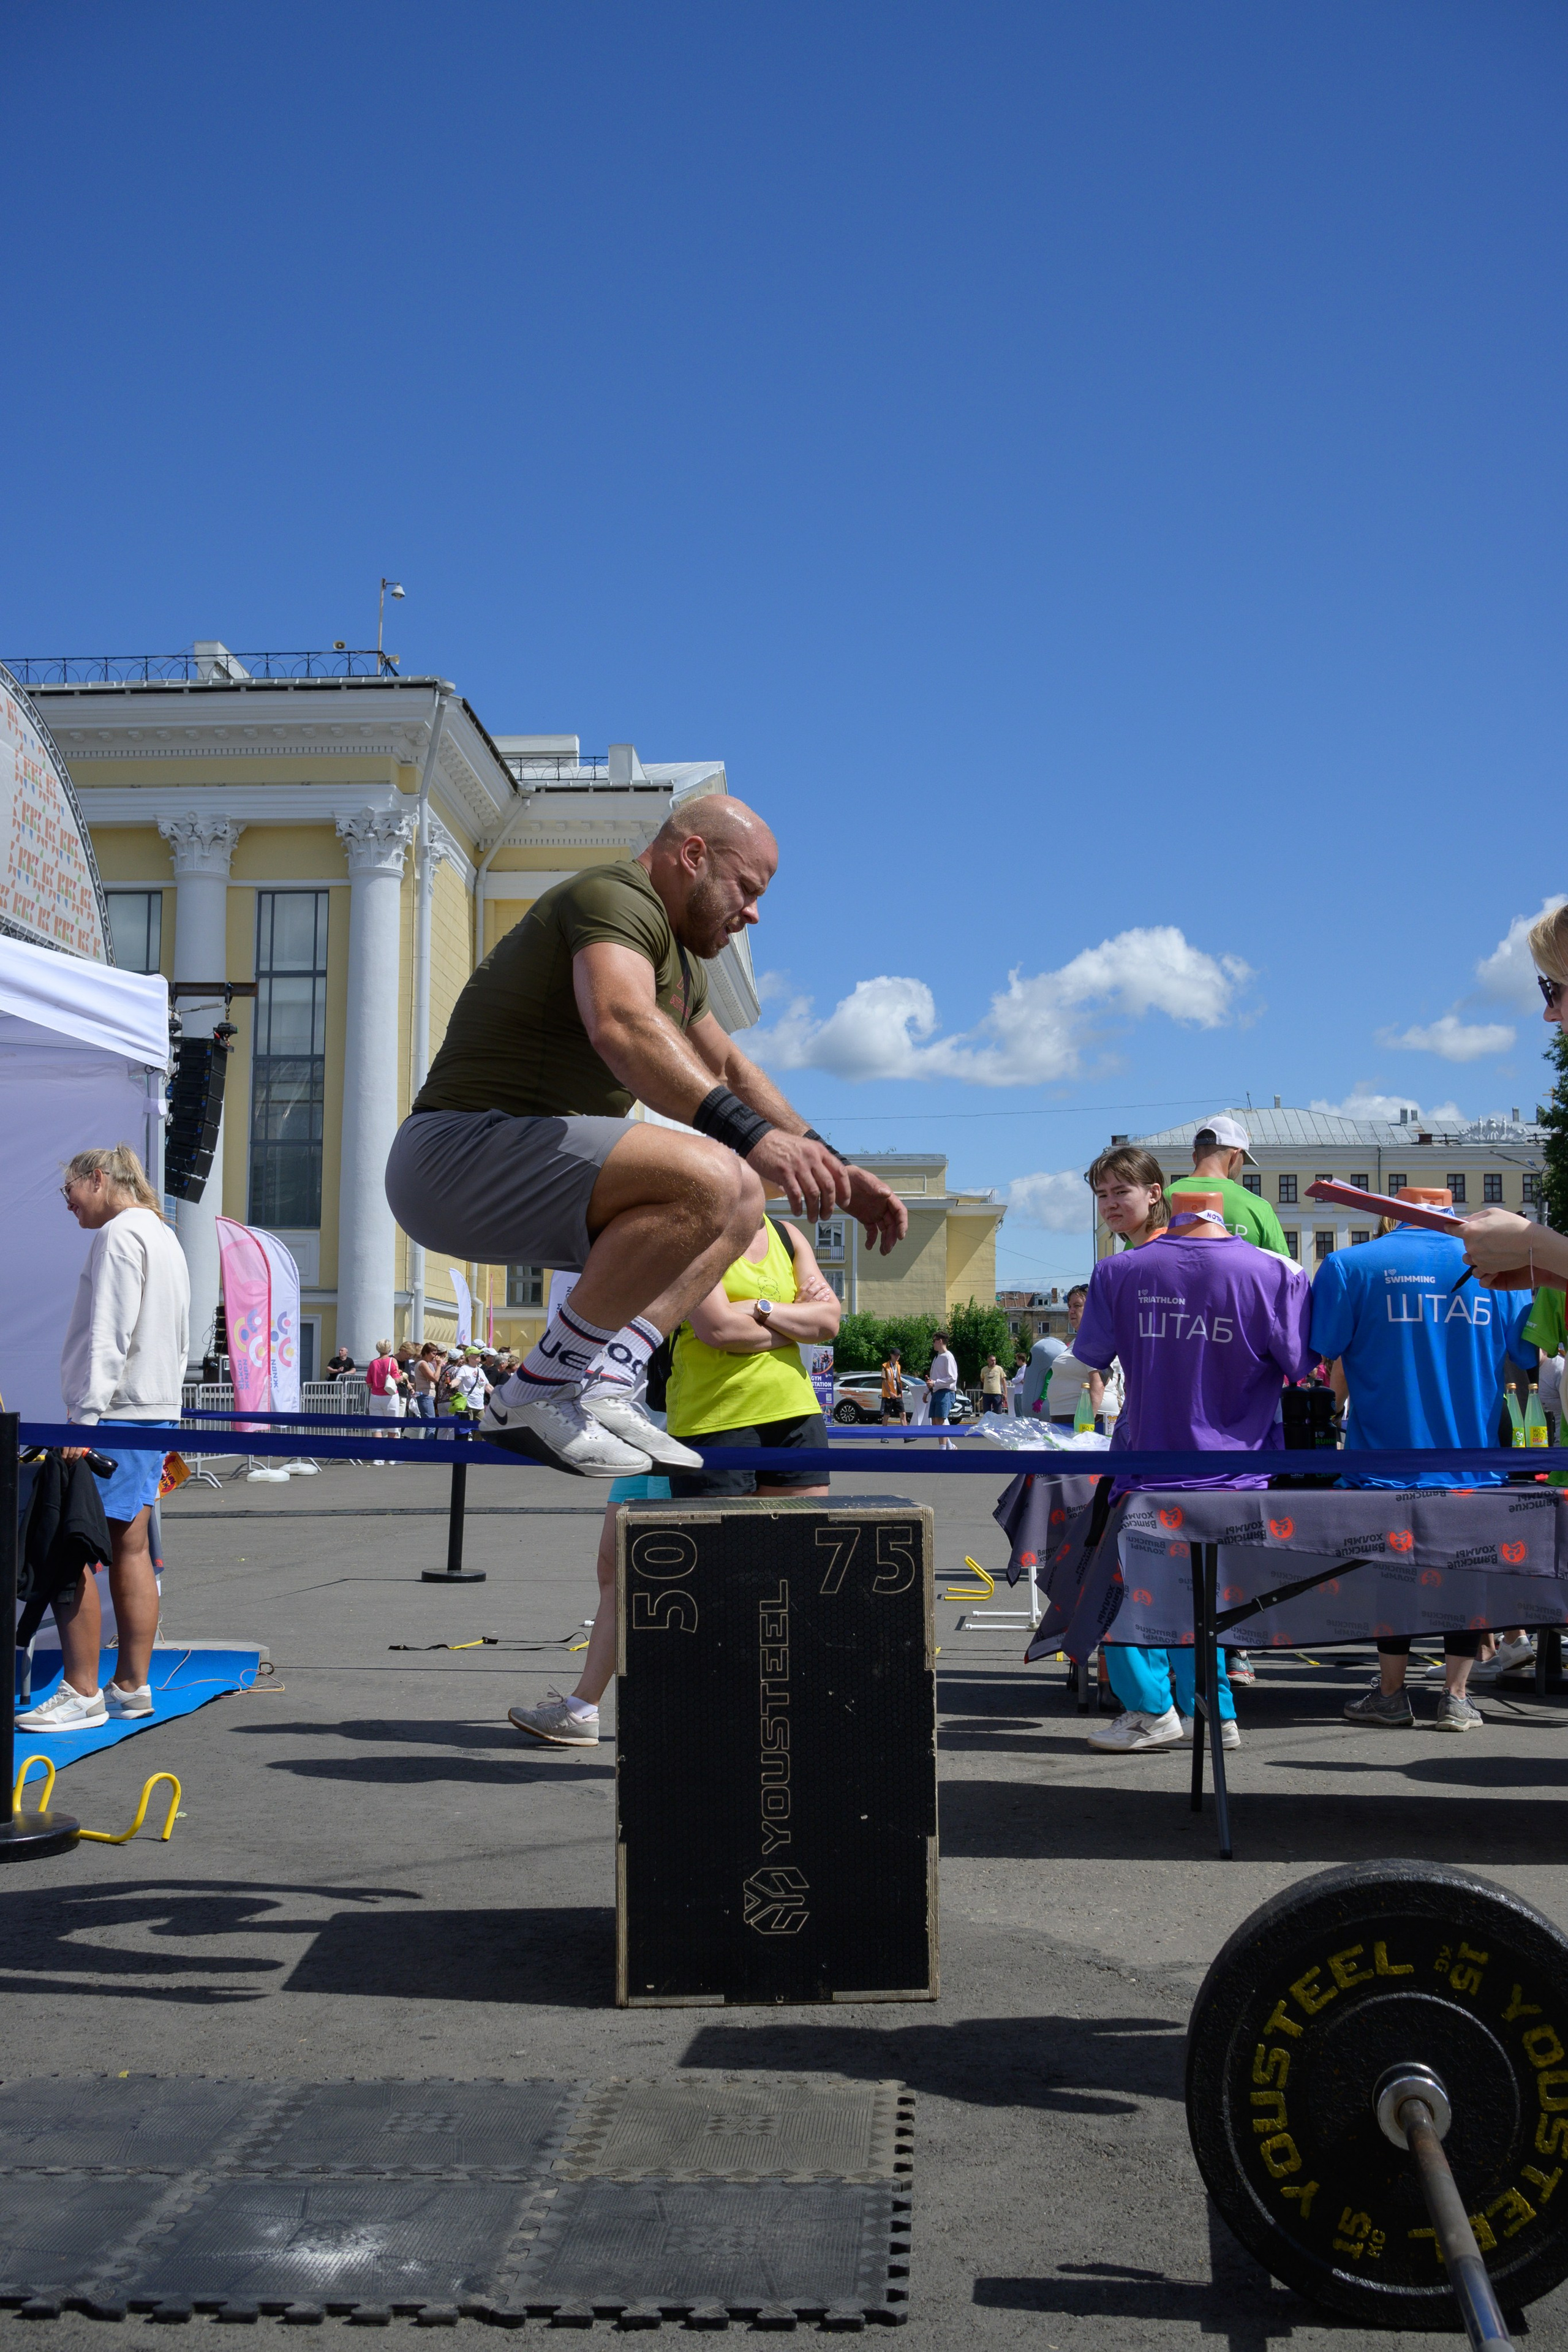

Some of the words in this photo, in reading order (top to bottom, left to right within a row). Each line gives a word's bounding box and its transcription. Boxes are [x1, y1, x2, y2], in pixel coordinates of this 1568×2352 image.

[1138, 1296, 1185, 1305] TRIATHLON
[1386, 1294, 1491, 1325] ШТАБ
[1139, 1312, 1233, 1343] ШТАБ
[1335, 1542, 1385, 1558] Вятские
[1344, 1533, 1383, 1546] холмы
[1456, 1544, 1496, 1558] холмы
[815, 1527, 915, 1594] 75
[1447, 1554, 1498, 1569] Вятские
[631, 1531, 698, 1633] 50
[760, 1580, 791, 1855] YOUSTEEL
[1250, 1940, 1415, 2220] YOUSTEEL
